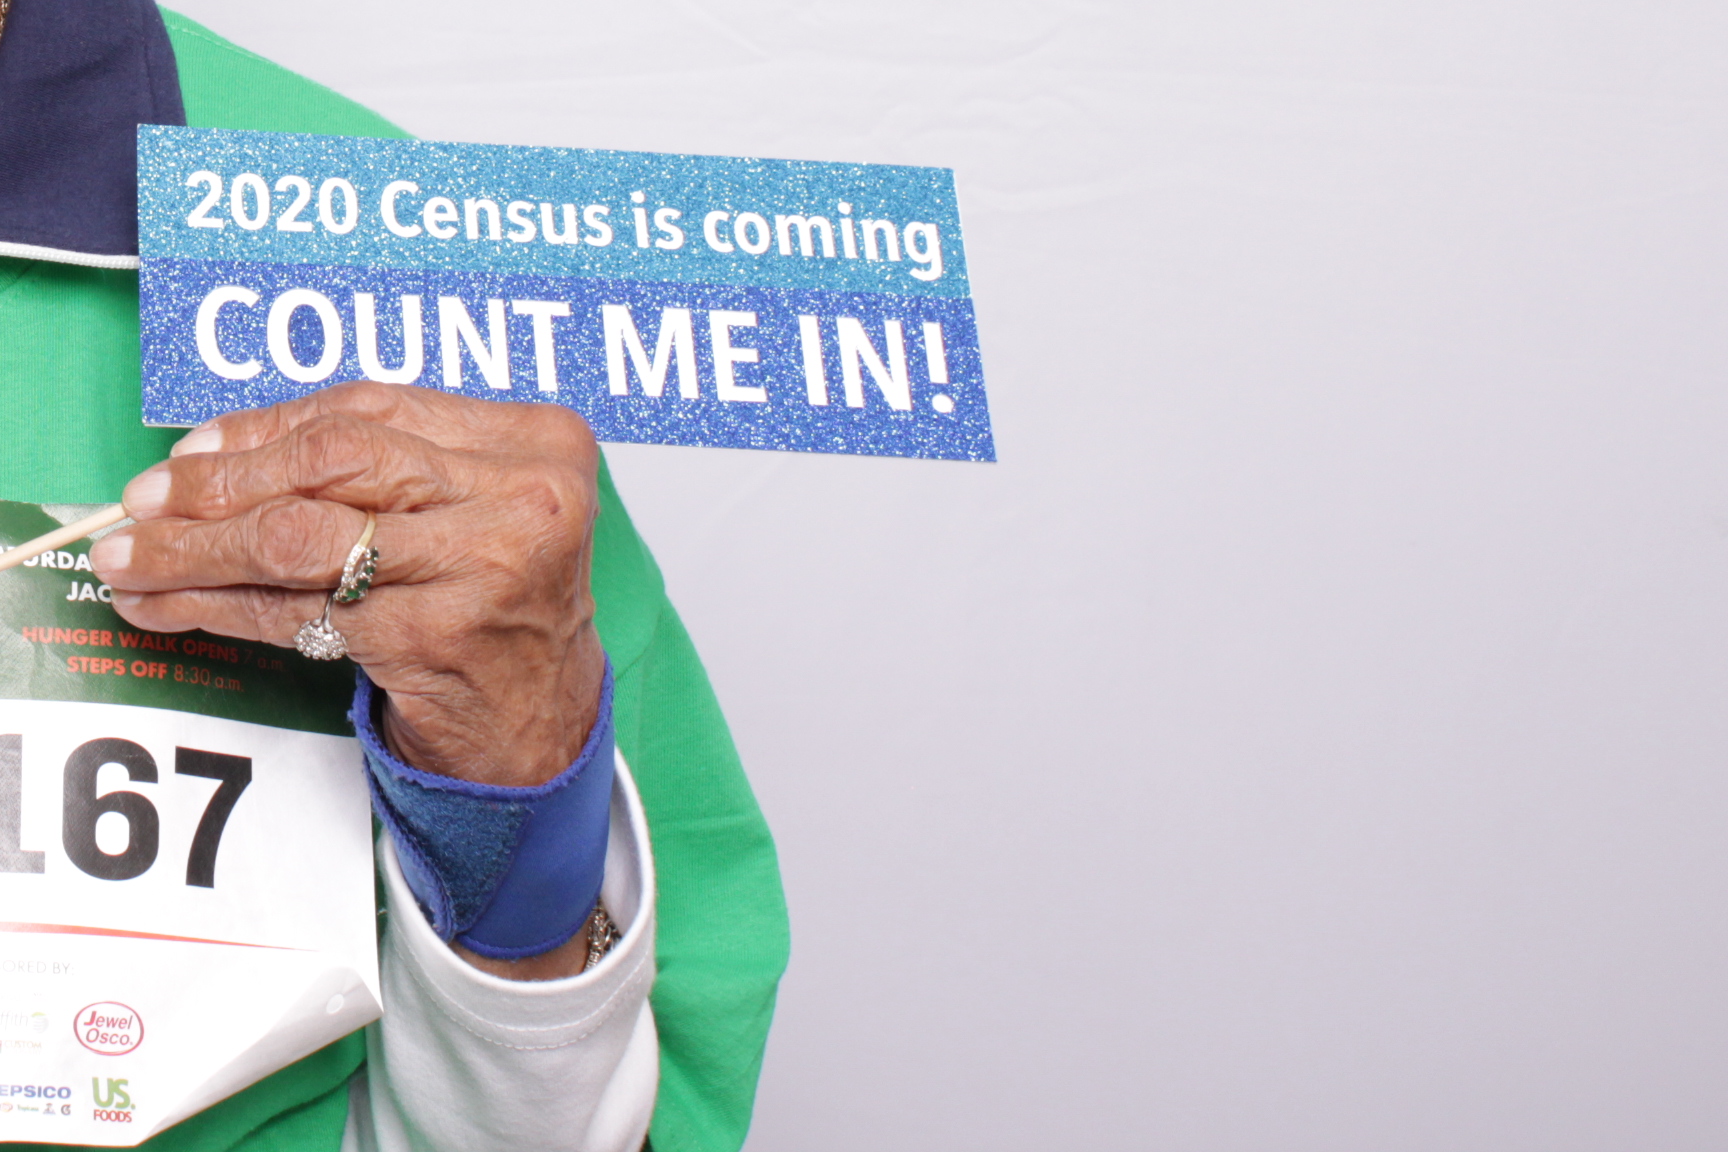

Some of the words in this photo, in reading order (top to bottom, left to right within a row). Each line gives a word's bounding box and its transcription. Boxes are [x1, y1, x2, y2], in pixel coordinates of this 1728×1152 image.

[186, 170, 359, 235] 2020
[380, 180, 613, 248] Census
[632, 191, 684, 250] is
[702, 201, 943, 281] coming
[194, 285, 571, 393] COUNT
[602, 303, 768, 403] ME
[798, 314, 954, 415] IN!
[66, 581, 112, 603] JAC
[22, 626, 114, 647] HUNGER
[118, 632, 178, 653] WALK
[182, 638, 239, 663] OPENS
[66, 656, 127, 676] STEPS
[131, 660, 168, 680] OFF
[173, 664, 211, 686] 8:30
[215, 675, 245, 693] a.m.
[83, 1009, 134, 1030] Jewel
[4, 1039, 43, 1049] CUSTOM
[93, 1109, 133, 1124] FOODS
